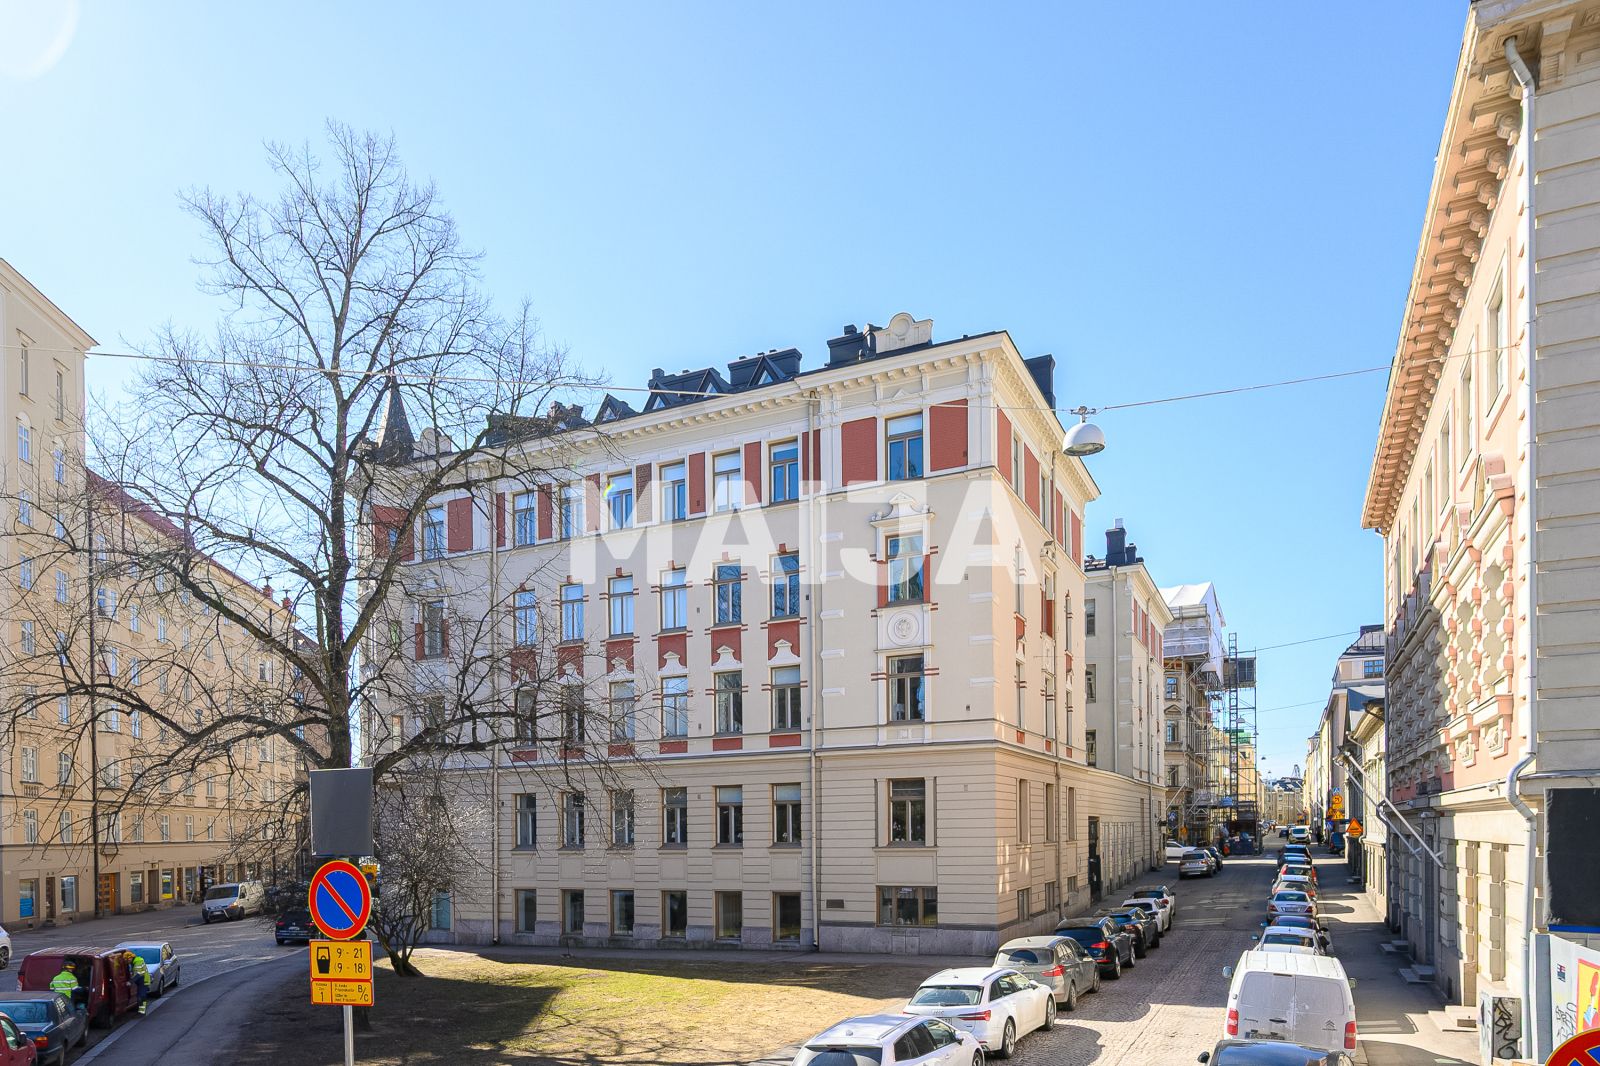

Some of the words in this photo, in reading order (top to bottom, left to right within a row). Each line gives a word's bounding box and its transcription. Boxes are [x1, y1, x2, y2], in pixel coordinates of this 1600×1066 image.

[336, 948, 342, 959] 9
[353, 948, 363, 959] 21
[354, 963, 366, 974] 18)
[320, 991, 324, 1002] 1
